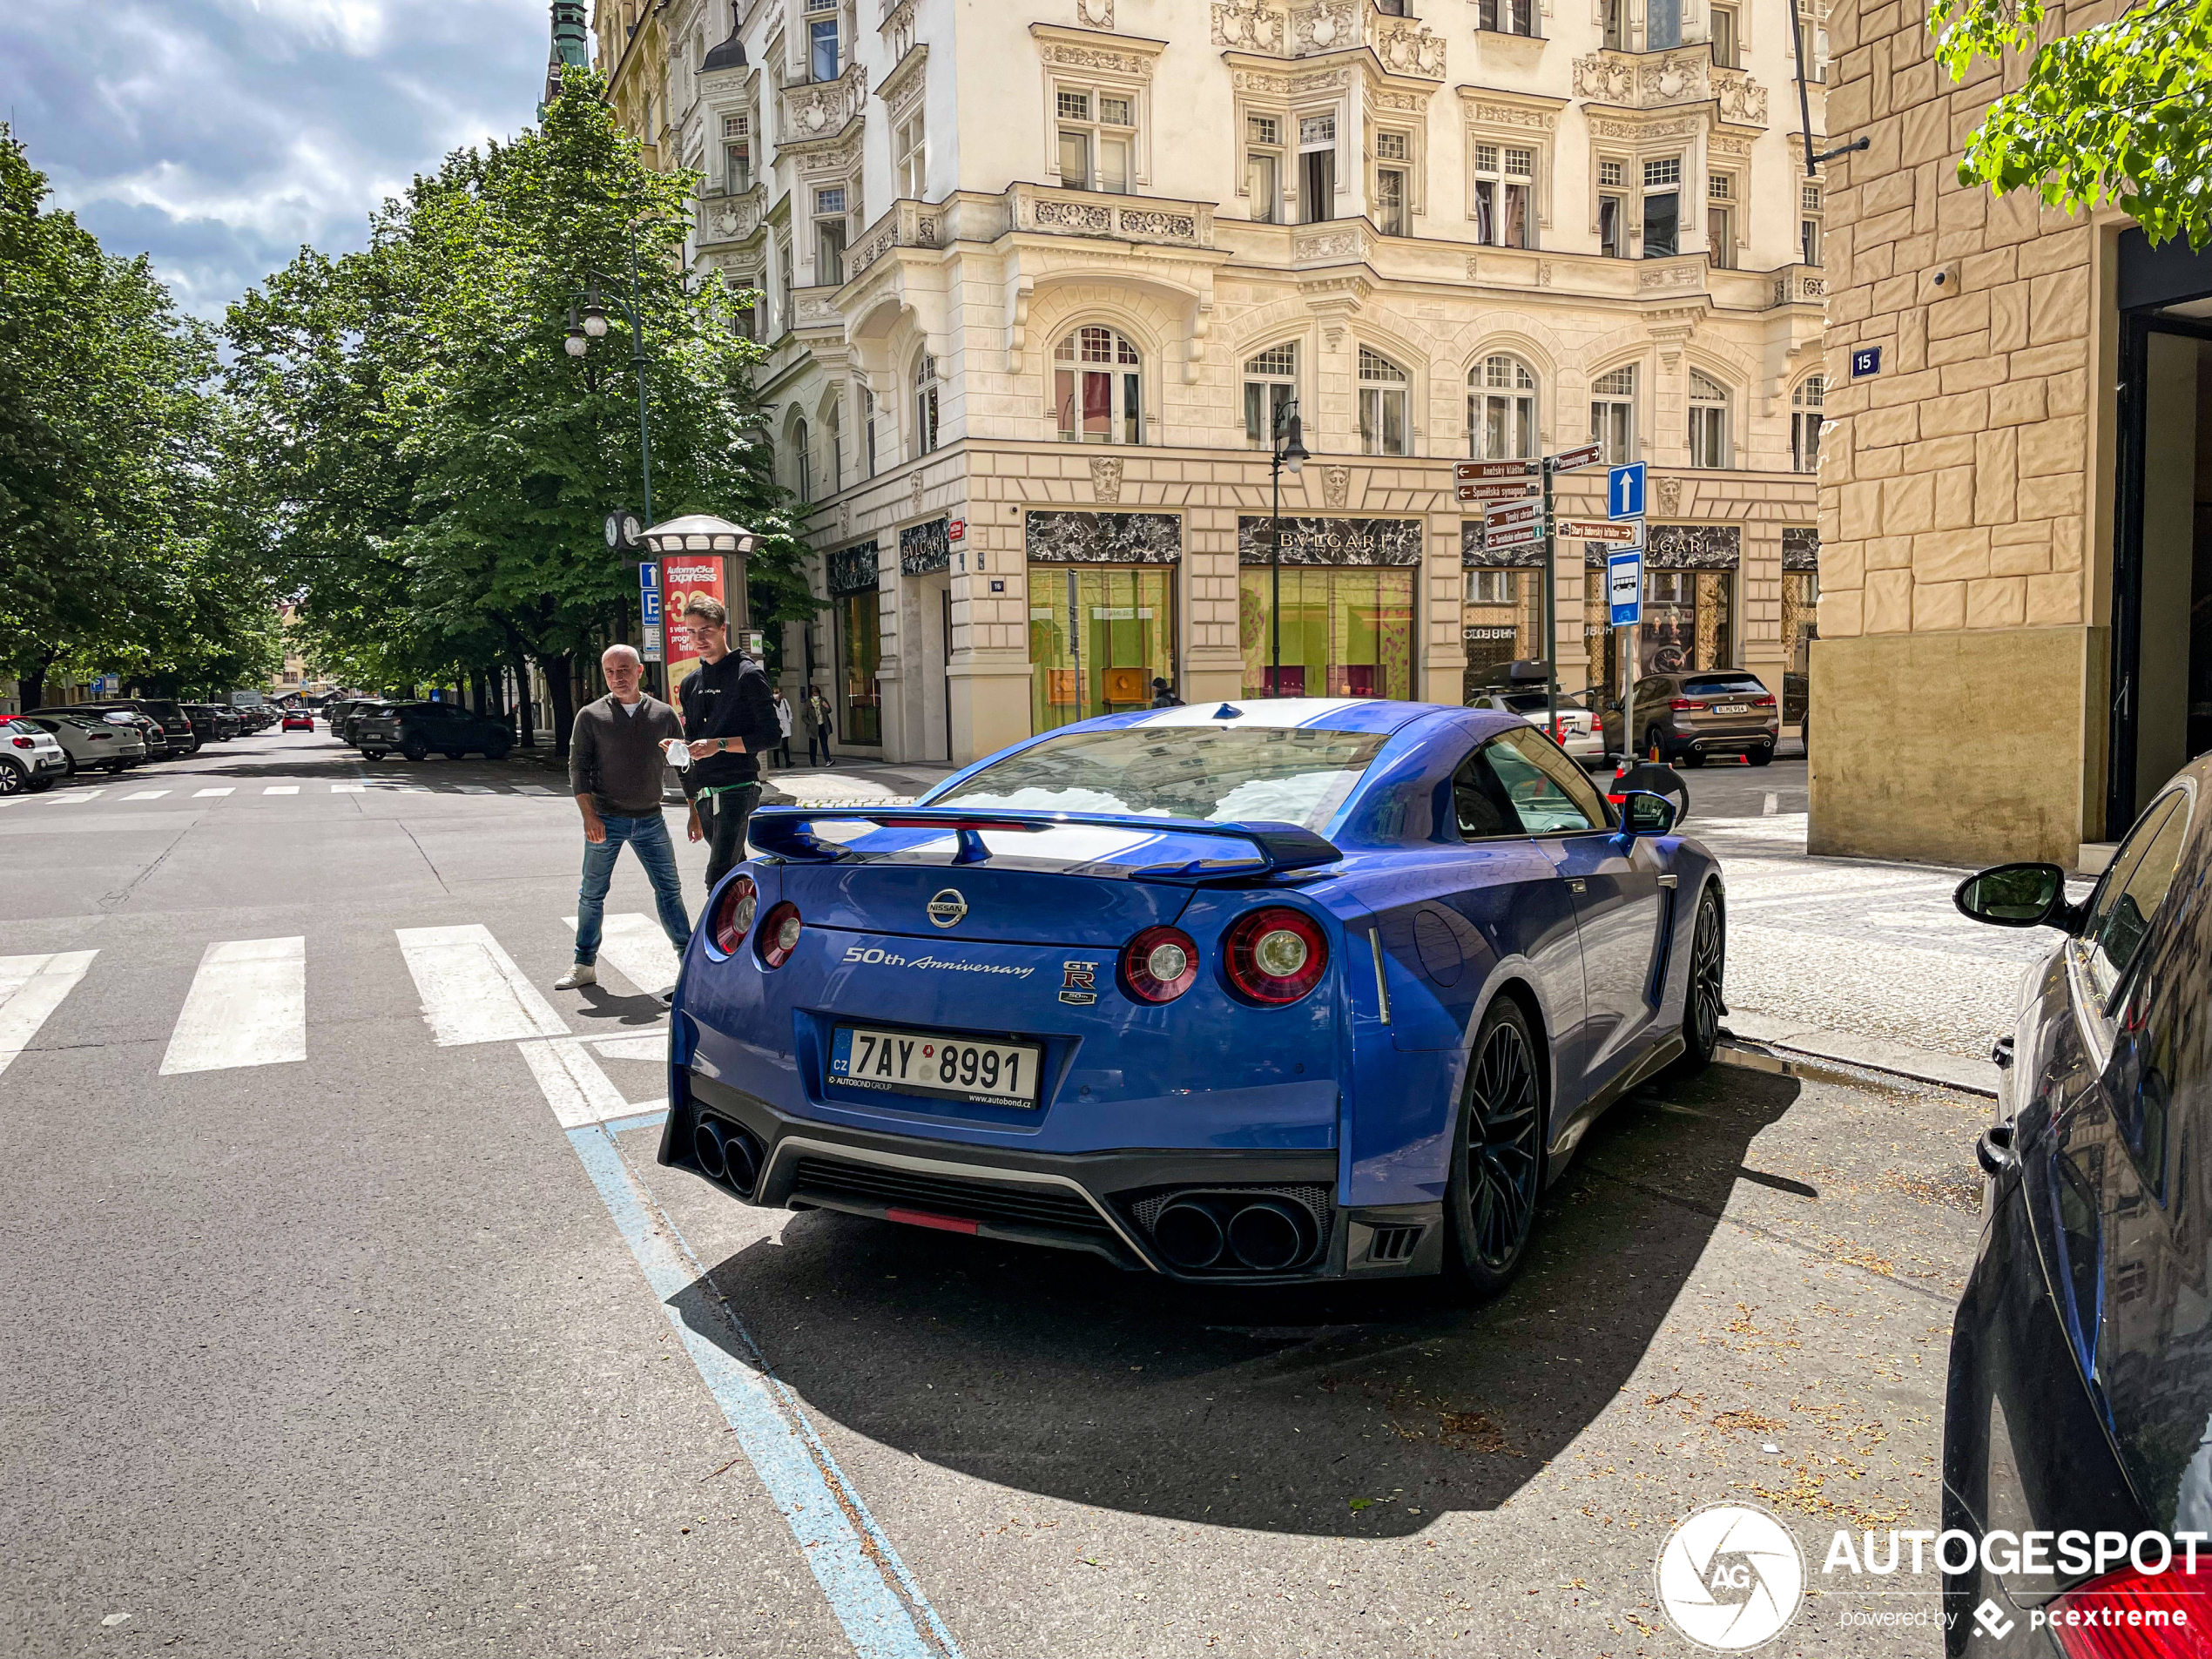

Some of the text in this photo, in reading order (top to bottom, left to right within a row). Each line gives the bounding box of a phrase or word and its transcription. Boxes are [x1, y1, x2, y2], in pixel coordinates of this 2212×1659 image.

[1858, 354, 1871, 370] 15
[1483, 465, 1525, 477] Anežský klášter
[1473, 486, 1527, 500] Španělská synagoga
[1505, 509, 1533, 524] Týnský chrám
[1571, 525, 1620, 539] Starý židovský hřbitov
[903, 536, 944, 559] BVLGARI
[1280, 533, 1386, 549] BVLGARI
[1649, 540, 1710, 553] LGARI
[667, 565, 714, 575] Automyčka
[670, 573, 718, 583] Express
[671, 636, 690, 644] progr
[752, 639, 761, 648] WC
[930, 904, 962, 913] NISSAN
[843, 947, 1035, 980] 50th Anniversary
[833, 1059, 847, 1071] CZ
[856, 1035, 1020, 1093] 7AY 8991
[836, 1077, 893, 1091] AUTOBOND GROUP
[968, 1094, 1032, 1109] www.autobond.cz
